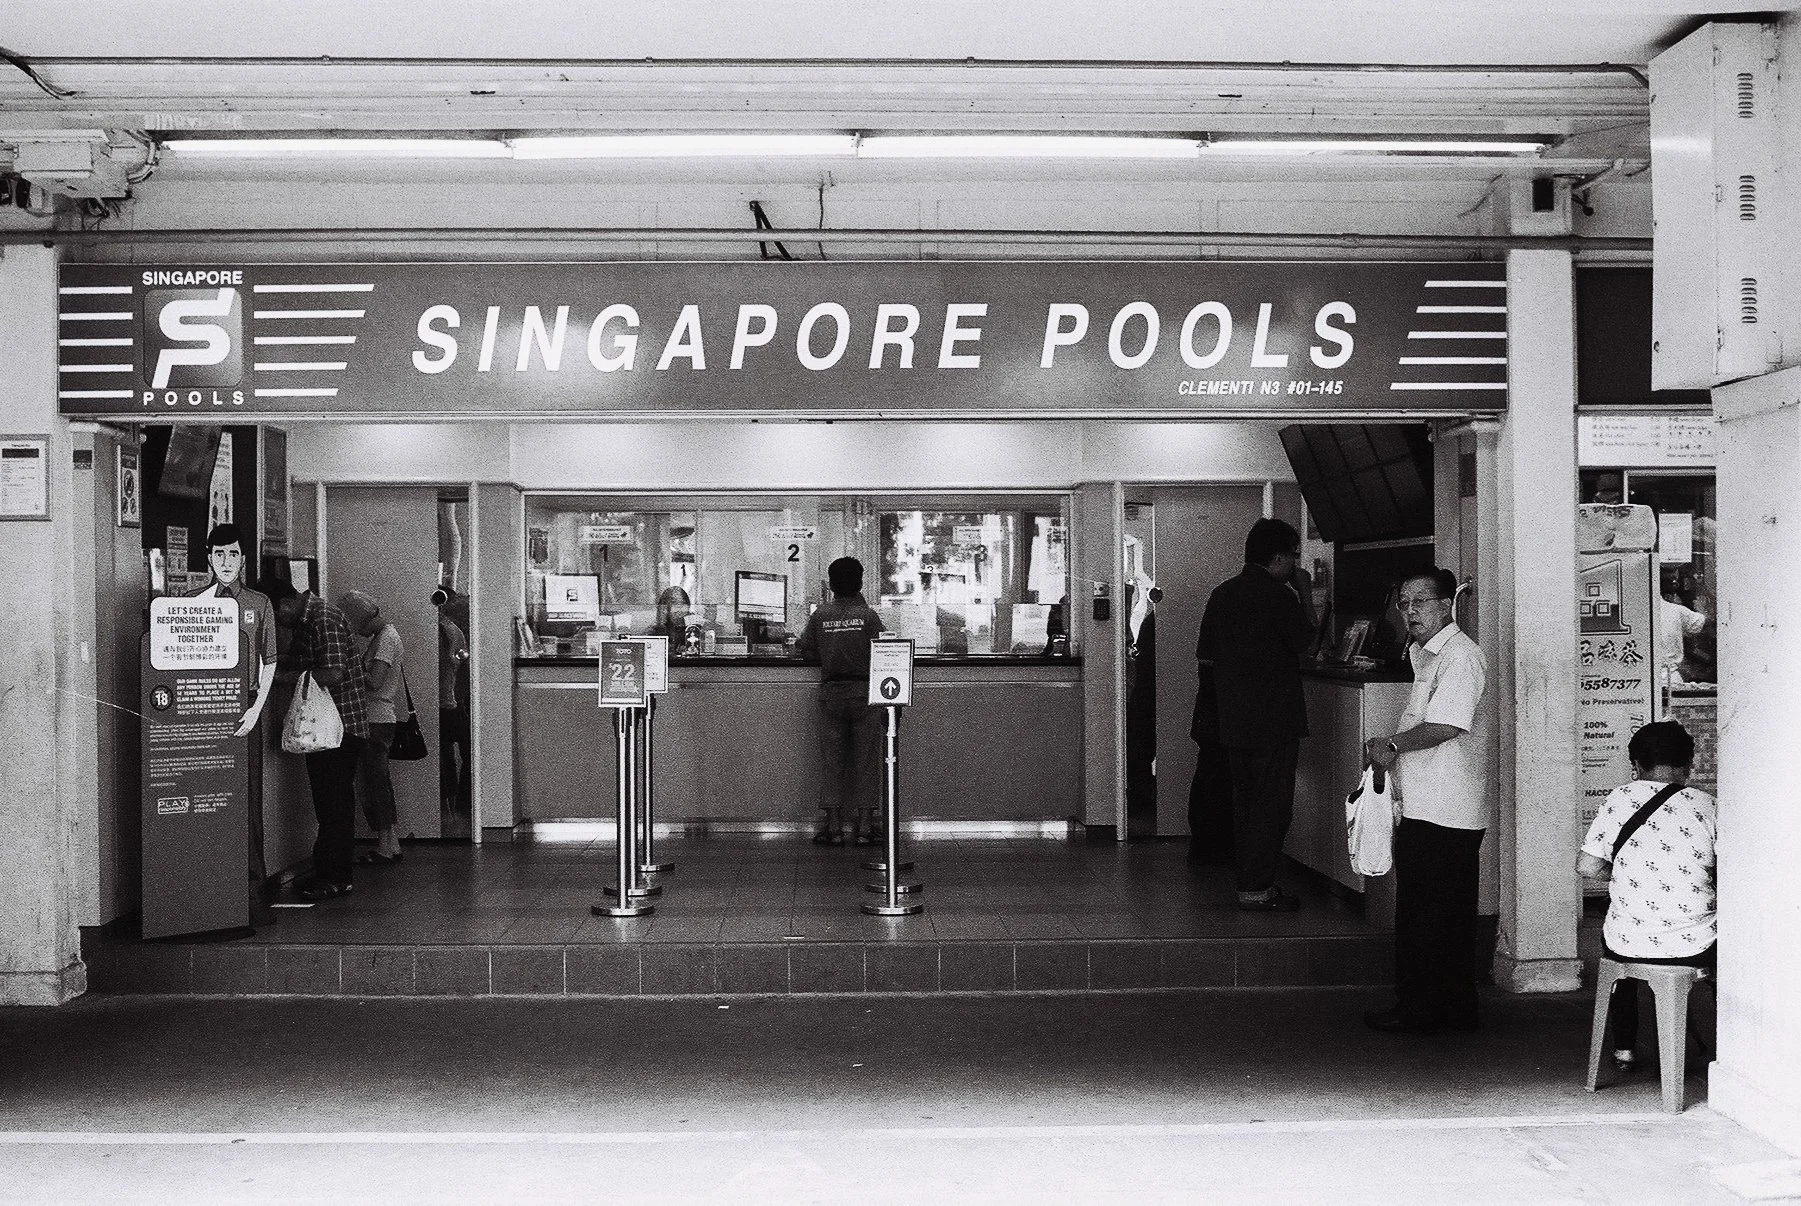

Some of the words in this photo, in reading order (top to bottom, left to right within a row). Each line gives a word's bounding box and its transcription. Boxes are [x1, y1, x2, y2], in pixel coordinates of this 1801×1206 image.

[142, 270, 243, 286] SINGAPORE
[411, 302, 988, 375] SINGAPORE
[1040, 301, 1357, 369] POOLS
[1178, 380, 1255, 395] CLEMENTI
[1259, 380, 1281, 395] N3
[1286, 380, 1344, 395] #01-145
[143, 390, 244, 406] POOLS
[787, 544, 800, 562] 2
[168, 606, 188, 615] LET'S
[189, 606, 216, 615] CREATE
[217, 606, 223, 615] A
[156, 616, 204, 624] RESPONSIBLE
[205, 616, 234, 624] GAMING
[170, 625, 221, 634] ENVIRONMENT
[177, 634, 214, 643] TOGETHER
[155, 692, 169, 706] 18
[1583, 721, 1609, 729] 100%
[1583, 731, 1615, 740] Natural
